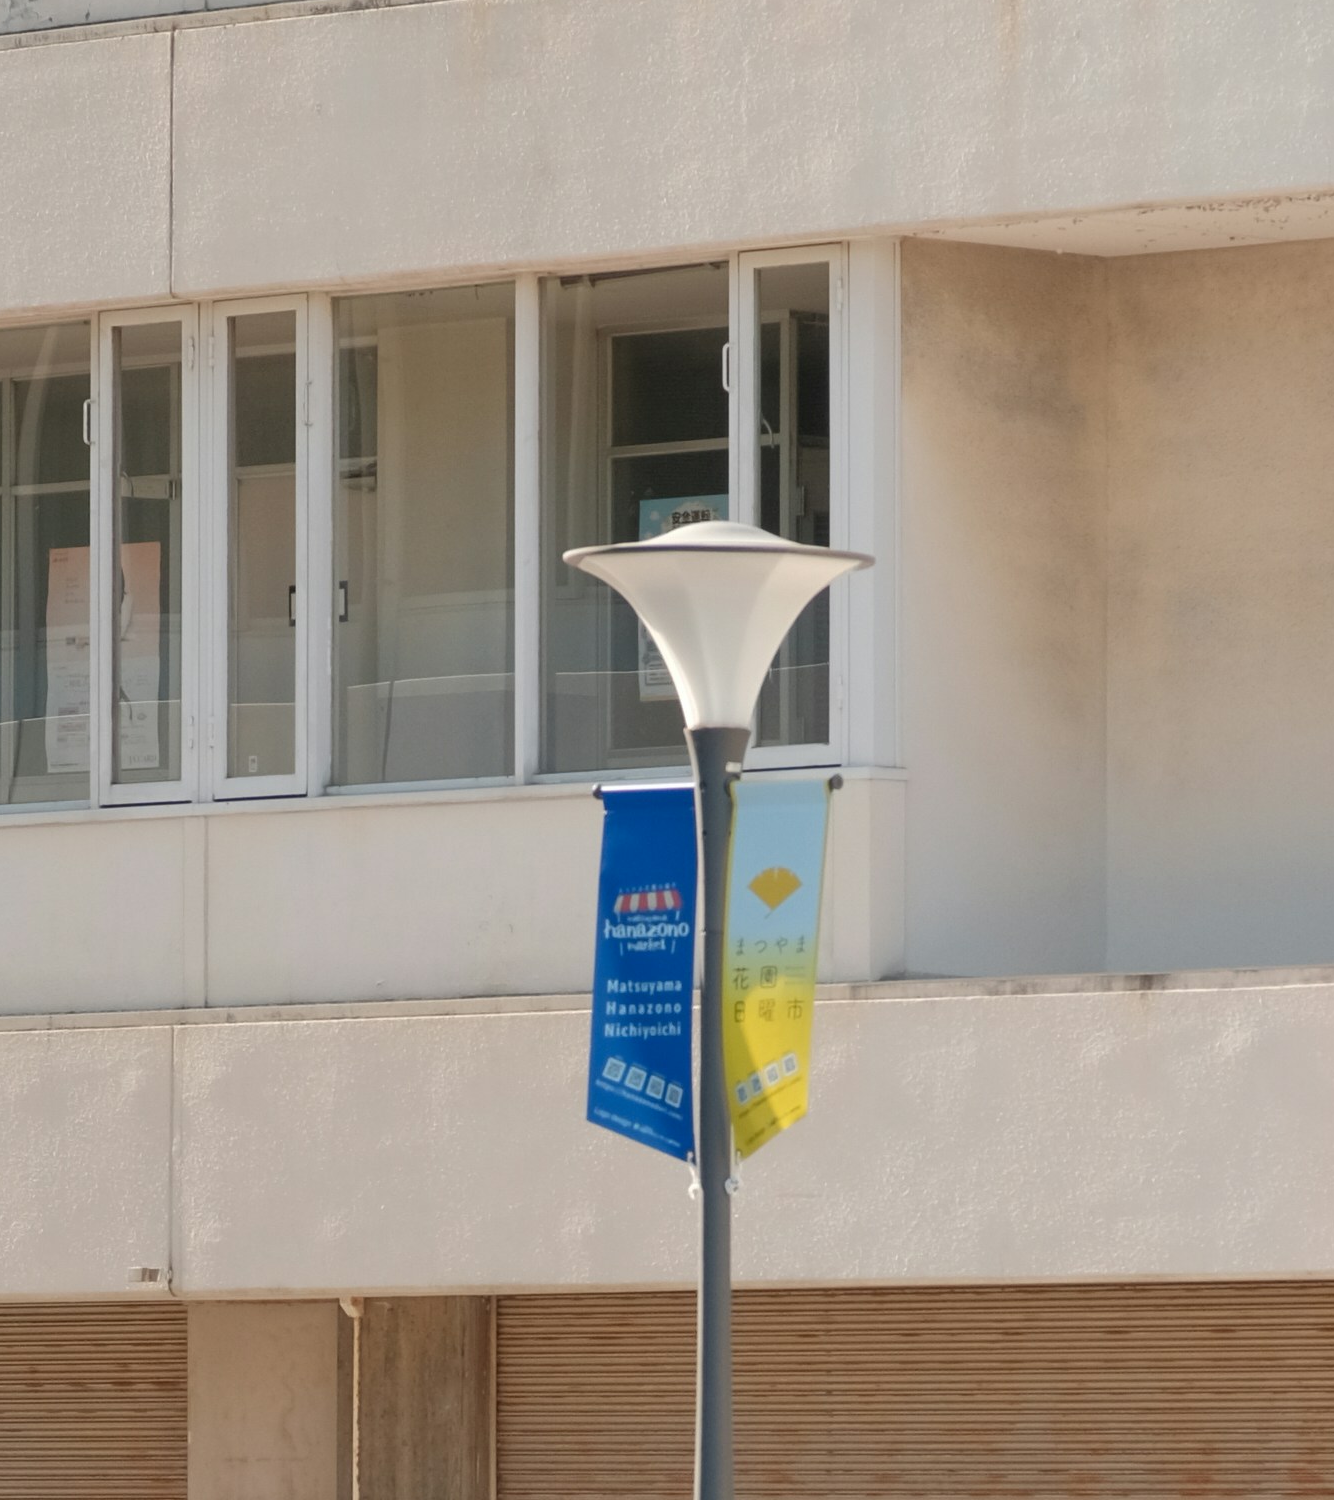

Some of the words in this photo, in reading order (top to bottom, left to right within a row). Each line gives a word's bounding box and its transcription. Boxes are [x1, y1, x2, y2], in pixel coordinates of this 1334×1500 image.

[604, 918, 690, 940] hanazono
[735, 935, 805, 956] まつやま
[607, 979, 682, 996] Matsuyama
[732, 965, 778, 990] 花園
[606, 1001, 682, 1015] Hanazono
[733, 997, 805, 1023] 日曜市
[604, 1021, 682, 1040] Nichiyoichi
